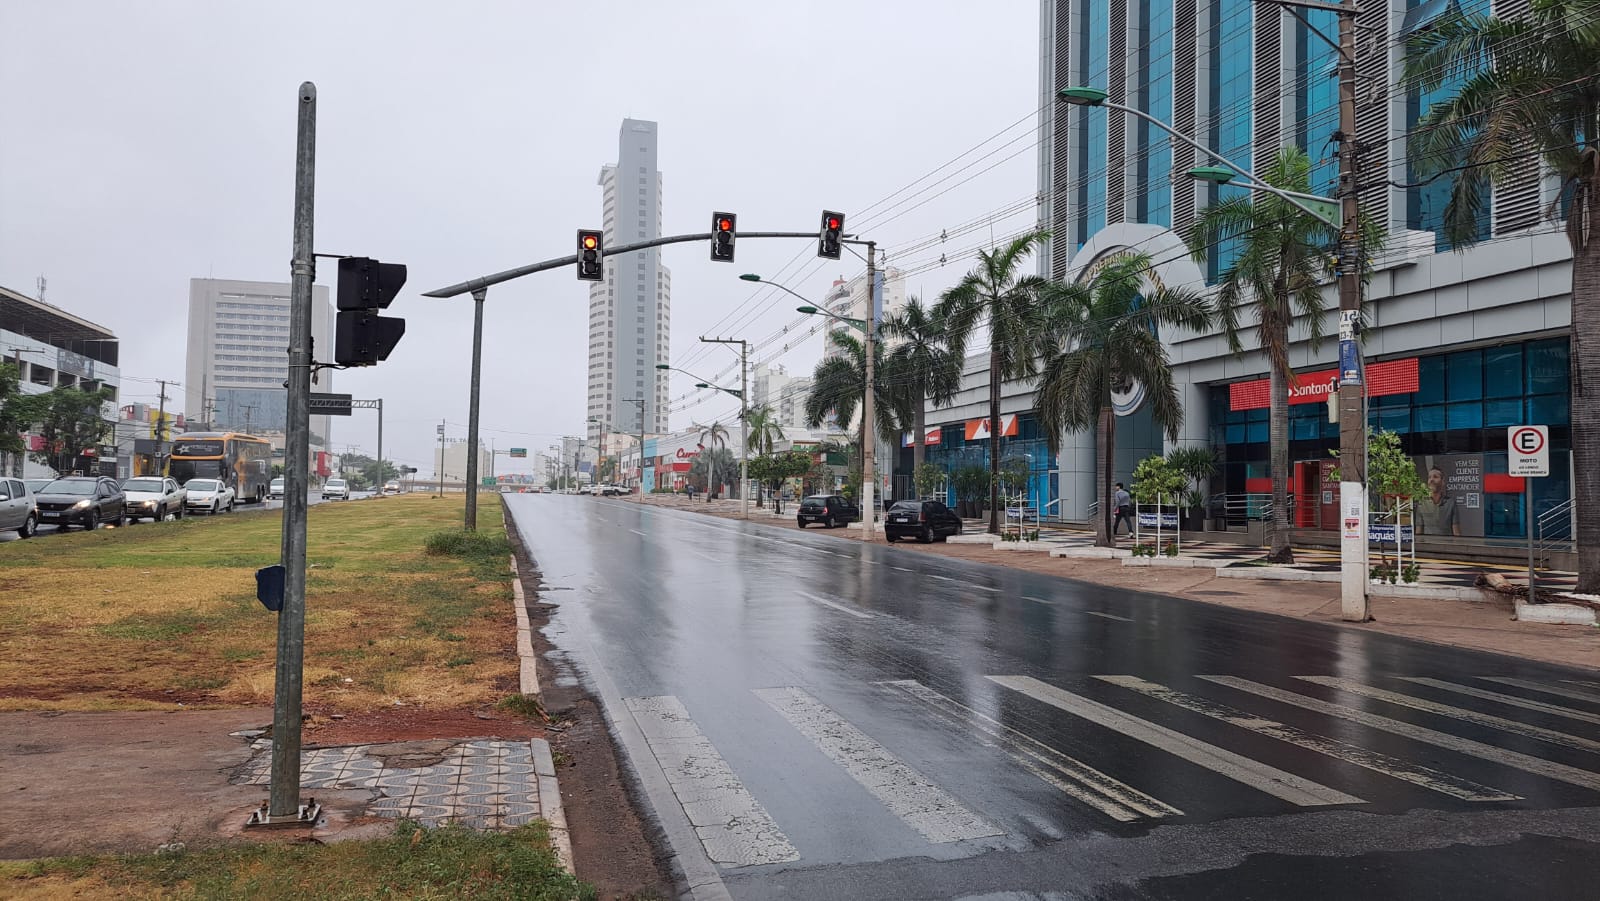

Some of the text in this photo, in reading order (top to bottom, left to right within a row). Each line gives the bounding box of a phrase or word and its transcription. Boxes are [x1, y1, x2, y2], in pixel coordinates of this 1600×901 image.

[1293, 377, 1340, 397] Santand
[1522, 433, 1535, 449] E
[1456, 467, 1480, 475] CLIENTE
[1448, 475, 1480, 483] EMPRESAS
[1446, 483, 1480, 491] SANTANDER
